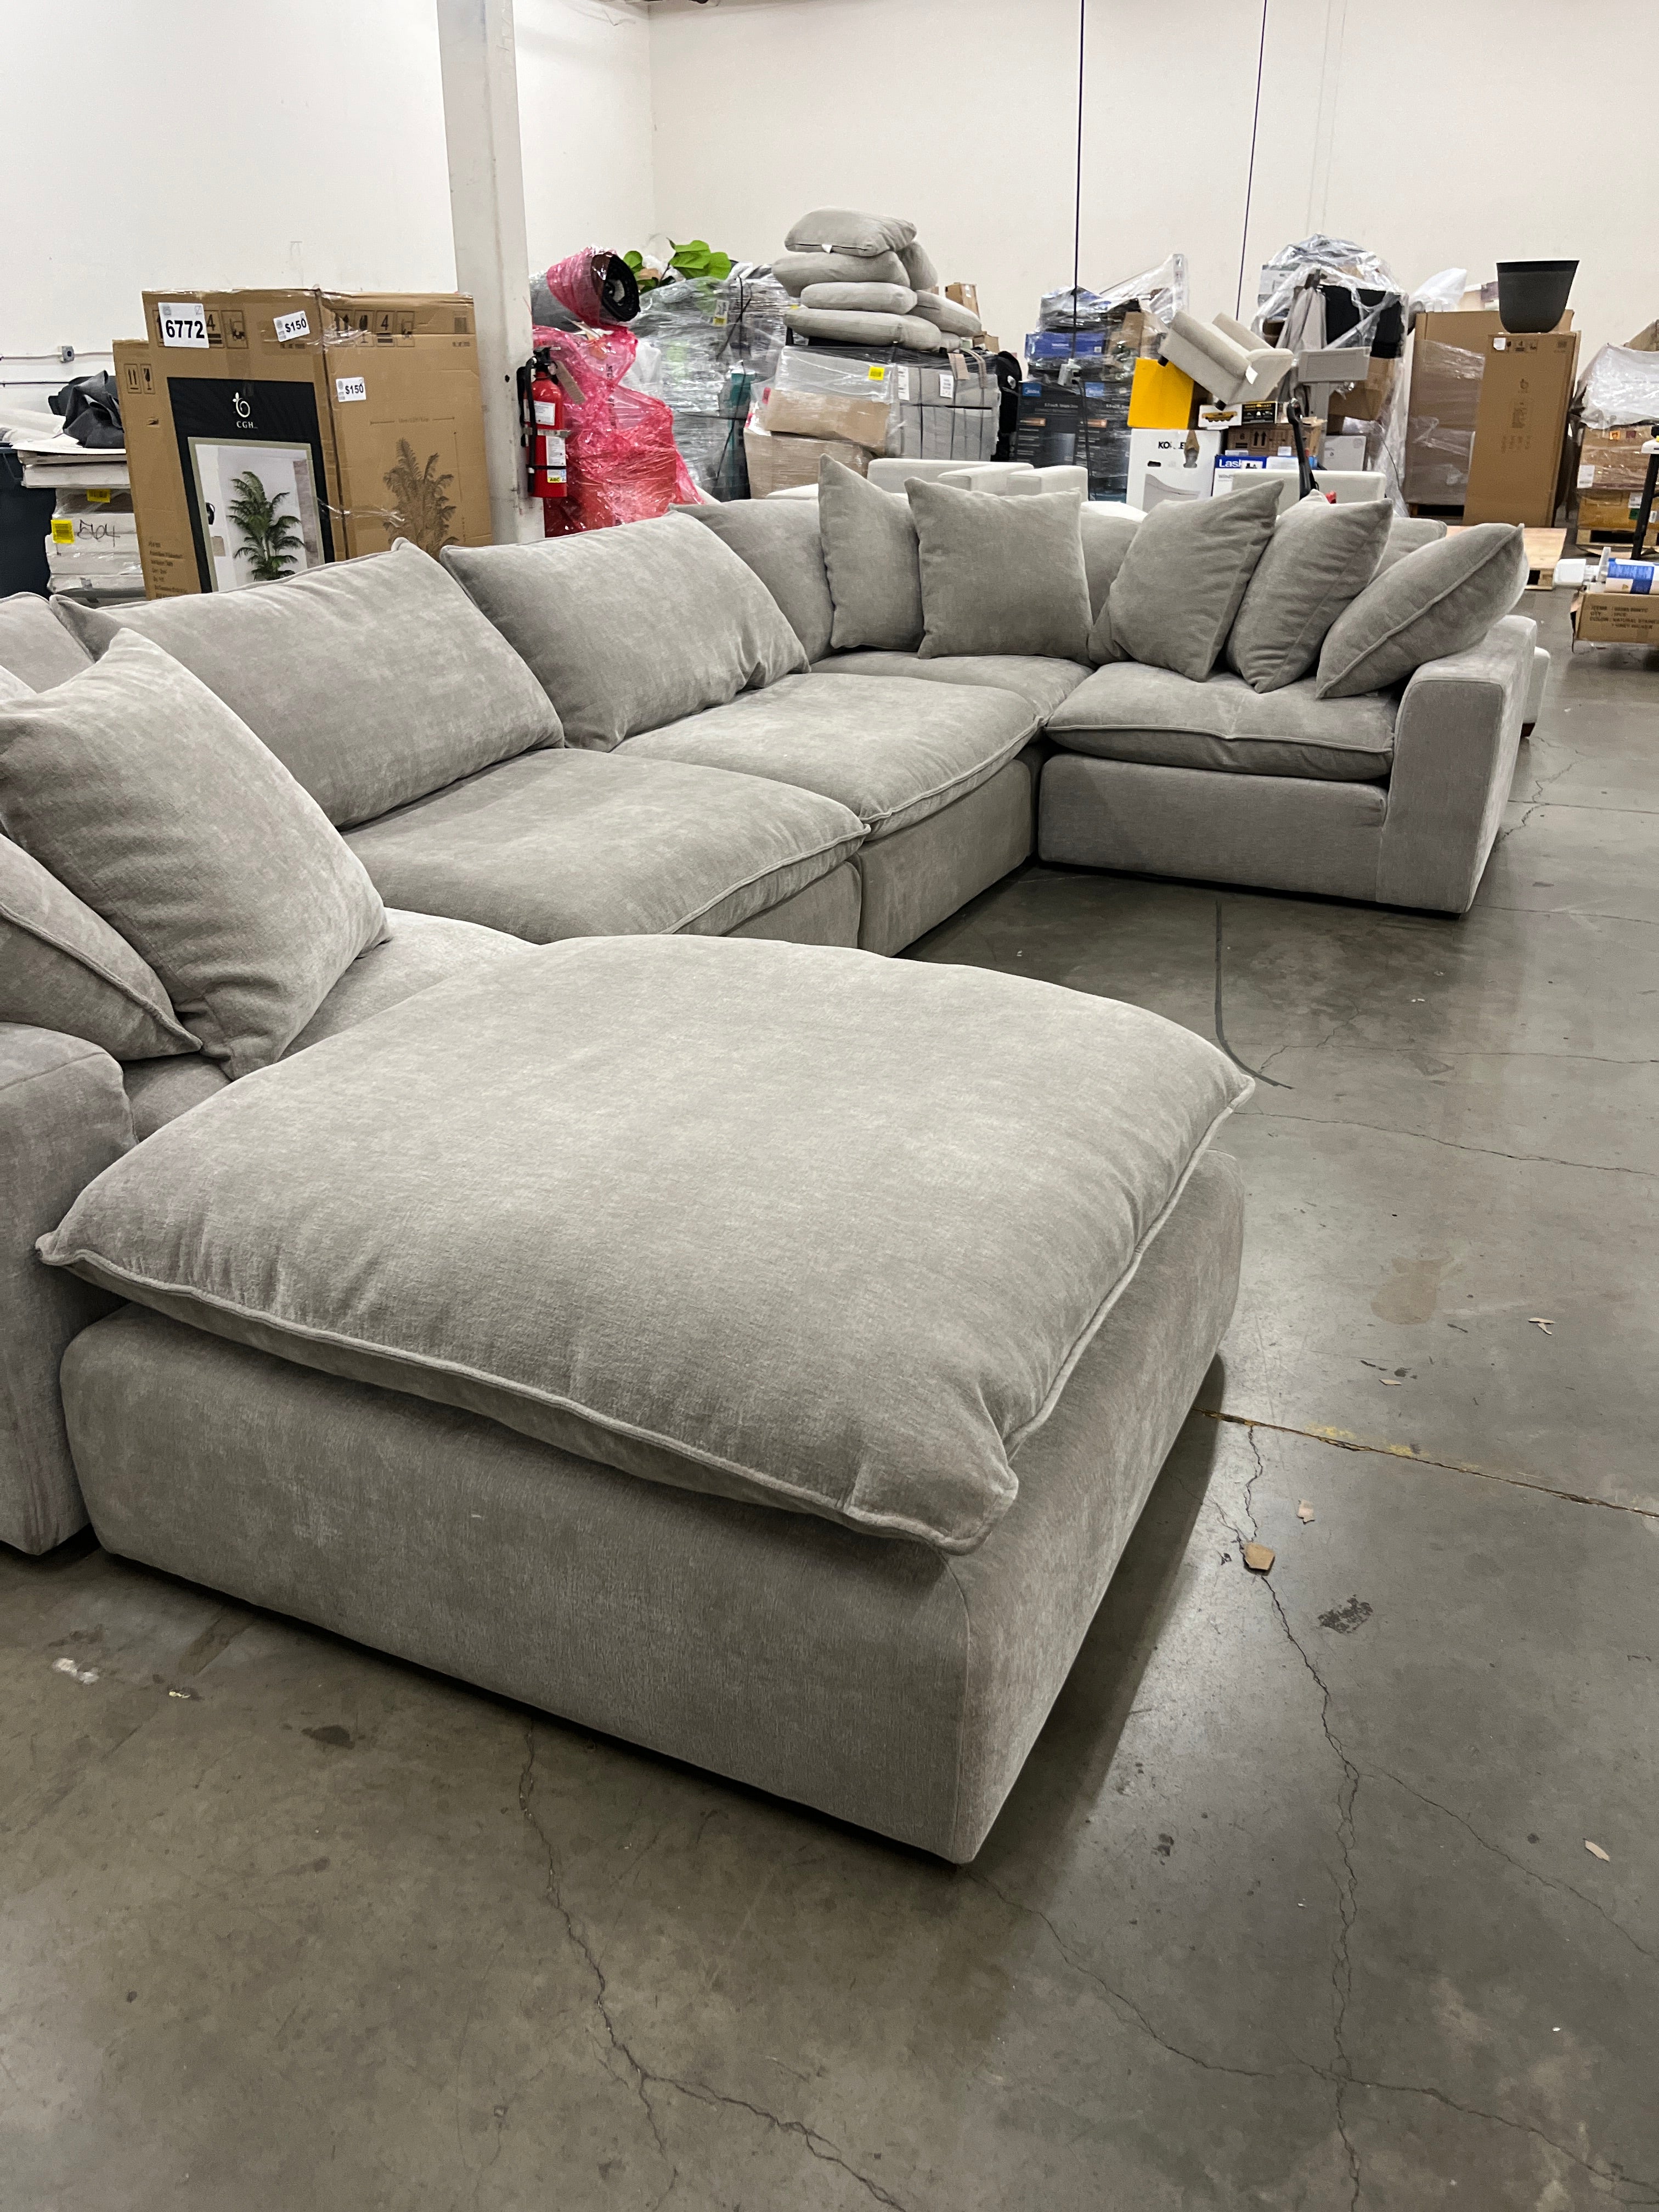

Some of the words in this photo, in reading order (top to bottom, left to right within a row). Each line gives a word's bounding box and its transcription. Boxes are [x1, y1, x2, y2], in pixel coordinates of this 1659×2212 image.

[165, 319, 205, 339] 6772
[284, 318, 307, 333] $150
[345, 383, 364, 395] $150
[1158, 441, 1186, 450] KOE
